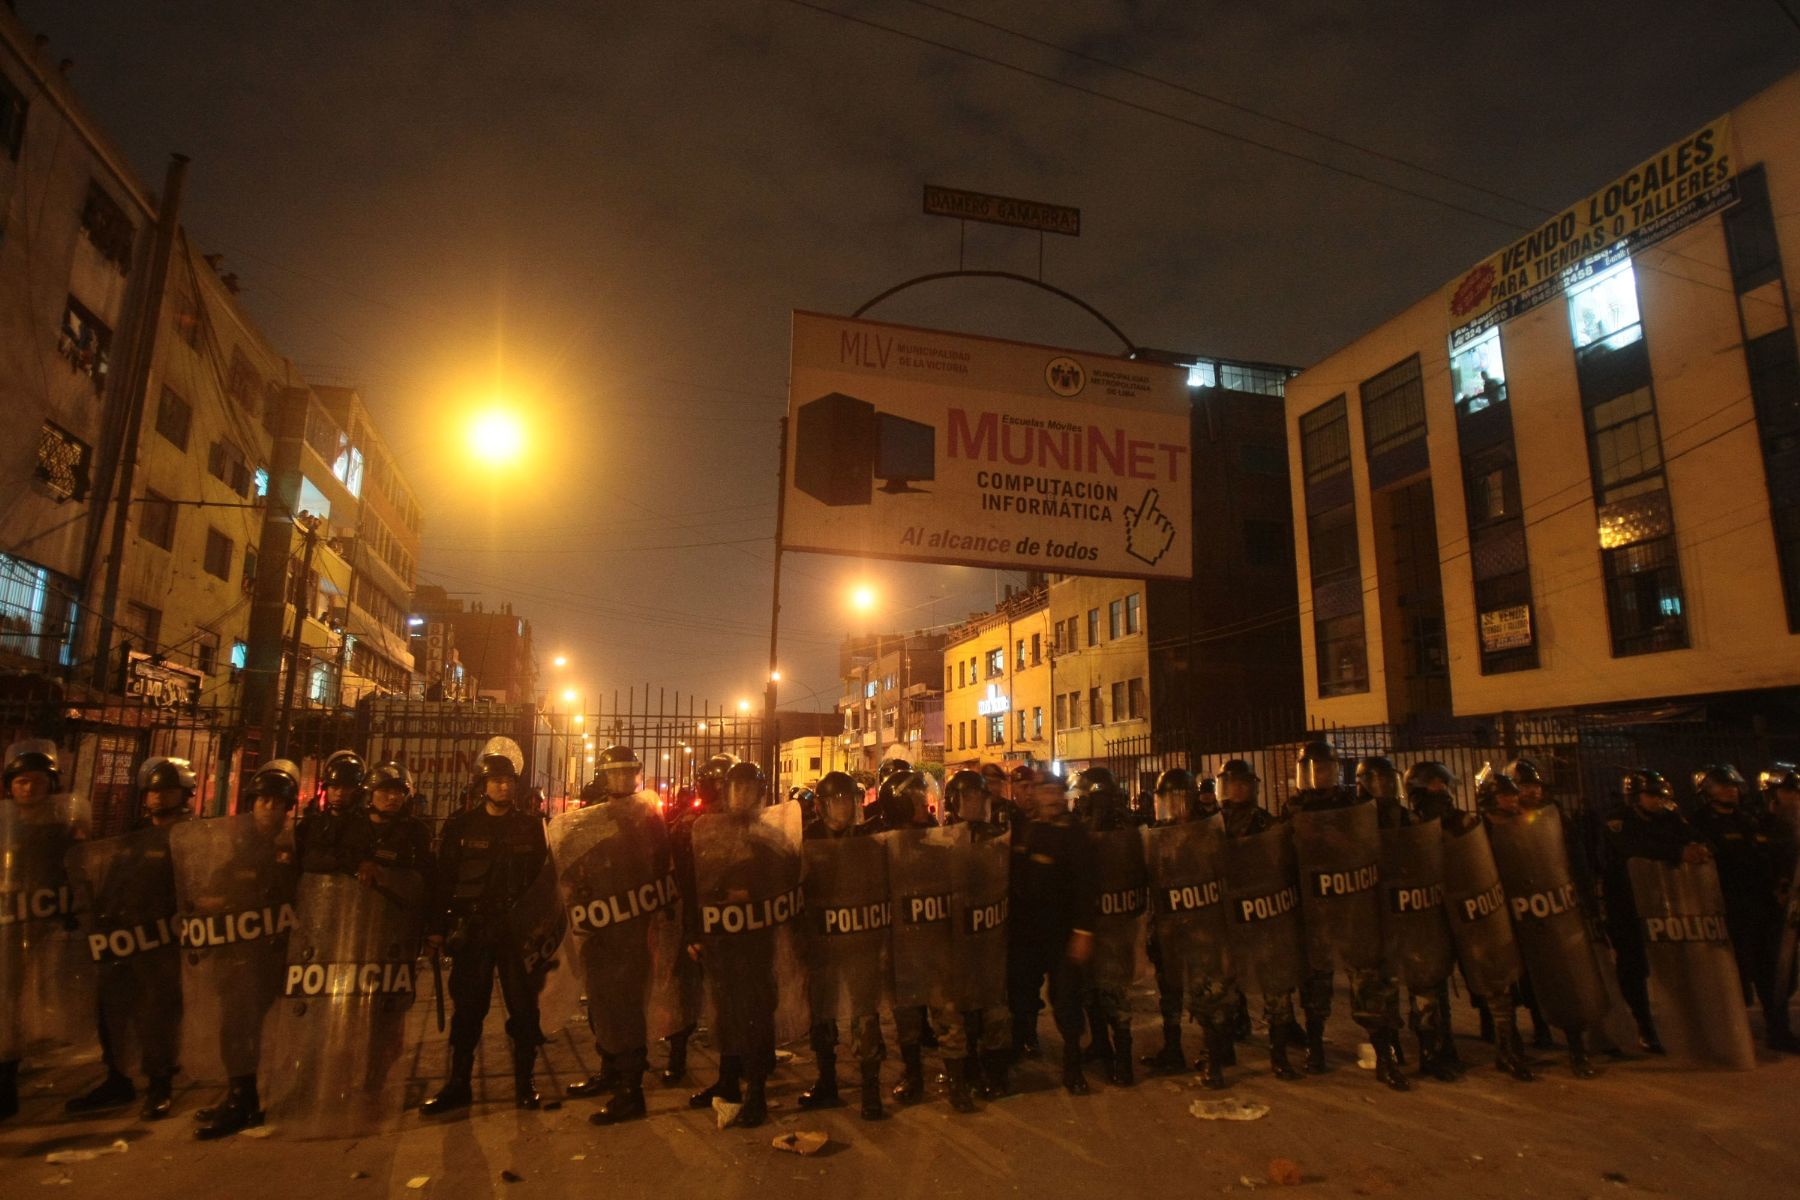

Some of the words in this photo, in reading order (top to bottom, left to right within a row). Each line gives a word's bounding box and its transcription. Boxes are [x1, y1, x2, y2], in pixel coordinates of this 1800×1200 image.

[1500, 211, 1576, 277] VENDO
[1589, 128, 1714, 227] LOCALES
[1490, 269, 1529, 304] PARA
[1535, 225, 1605, 281] TIENDAS
[1613, 215, 1624, 237] O
[1632, 155, 1729, 227] TALLERES
[840, 329, 893, 368] MLV
[897, 343, 970, 361] MUNICIPALIDAD
[899, 356, 912, 367] DE
[913, 357, 925, 369] LA
[927, 359, 969, 374] VICTORIA
[1002, 414, 1044, 429] Escuelas
[1047, 419, 1082, 433] Móviles
[977, 471, 1118, 502] COMPUTACIÓN
[982, 492, 1112, 522] INFORMÁTICA
[901, 526, 923, 548] Al
[929, 530, 1011, 553] alcance
[1016, 536, 1040, 556] de
[1045, 540, 1099, 561] todos
[570, 873, 681, 930] POLICIA
[703, 885, 804, 934] POLICIA
[180, 903, 300, 947] POLICIA
[285, 962, 414, 997] POLICIA
